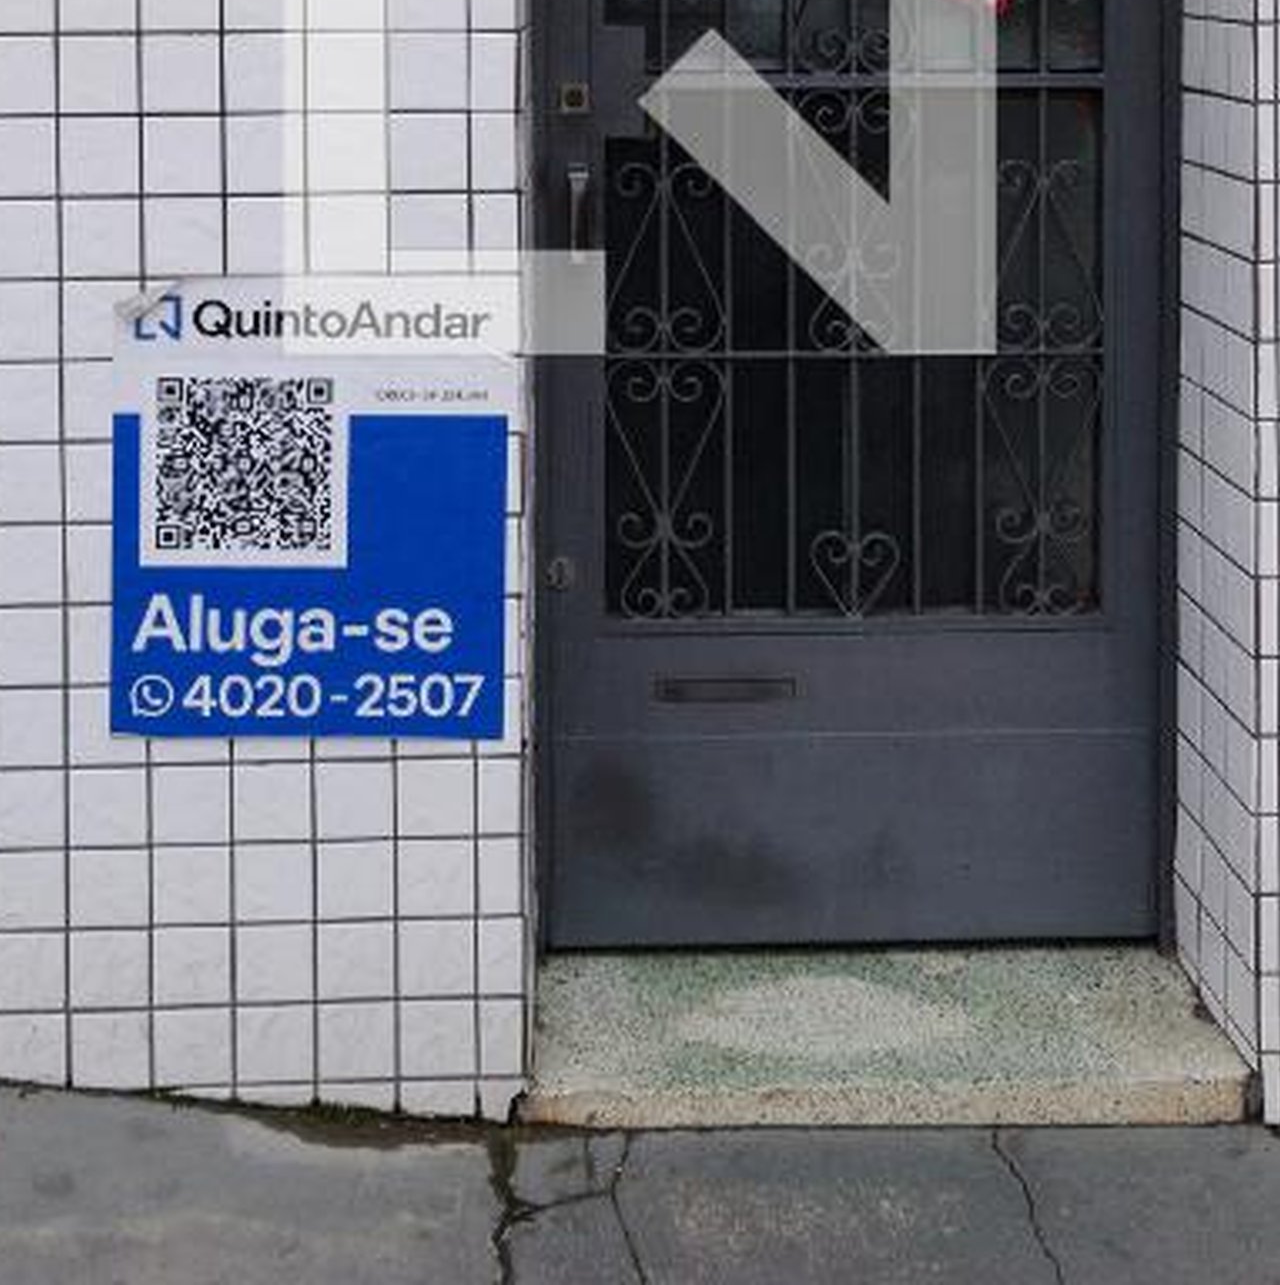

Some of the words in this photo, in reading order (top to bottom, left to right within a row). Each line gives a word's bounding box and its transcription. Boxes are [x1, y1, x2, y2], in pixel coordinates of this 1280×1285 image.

[192, 299, 491, 340] QuintoAndar
[131, 593, 454, 667] Aluga-se
[182, 673, 486, 718] 4020-2507
